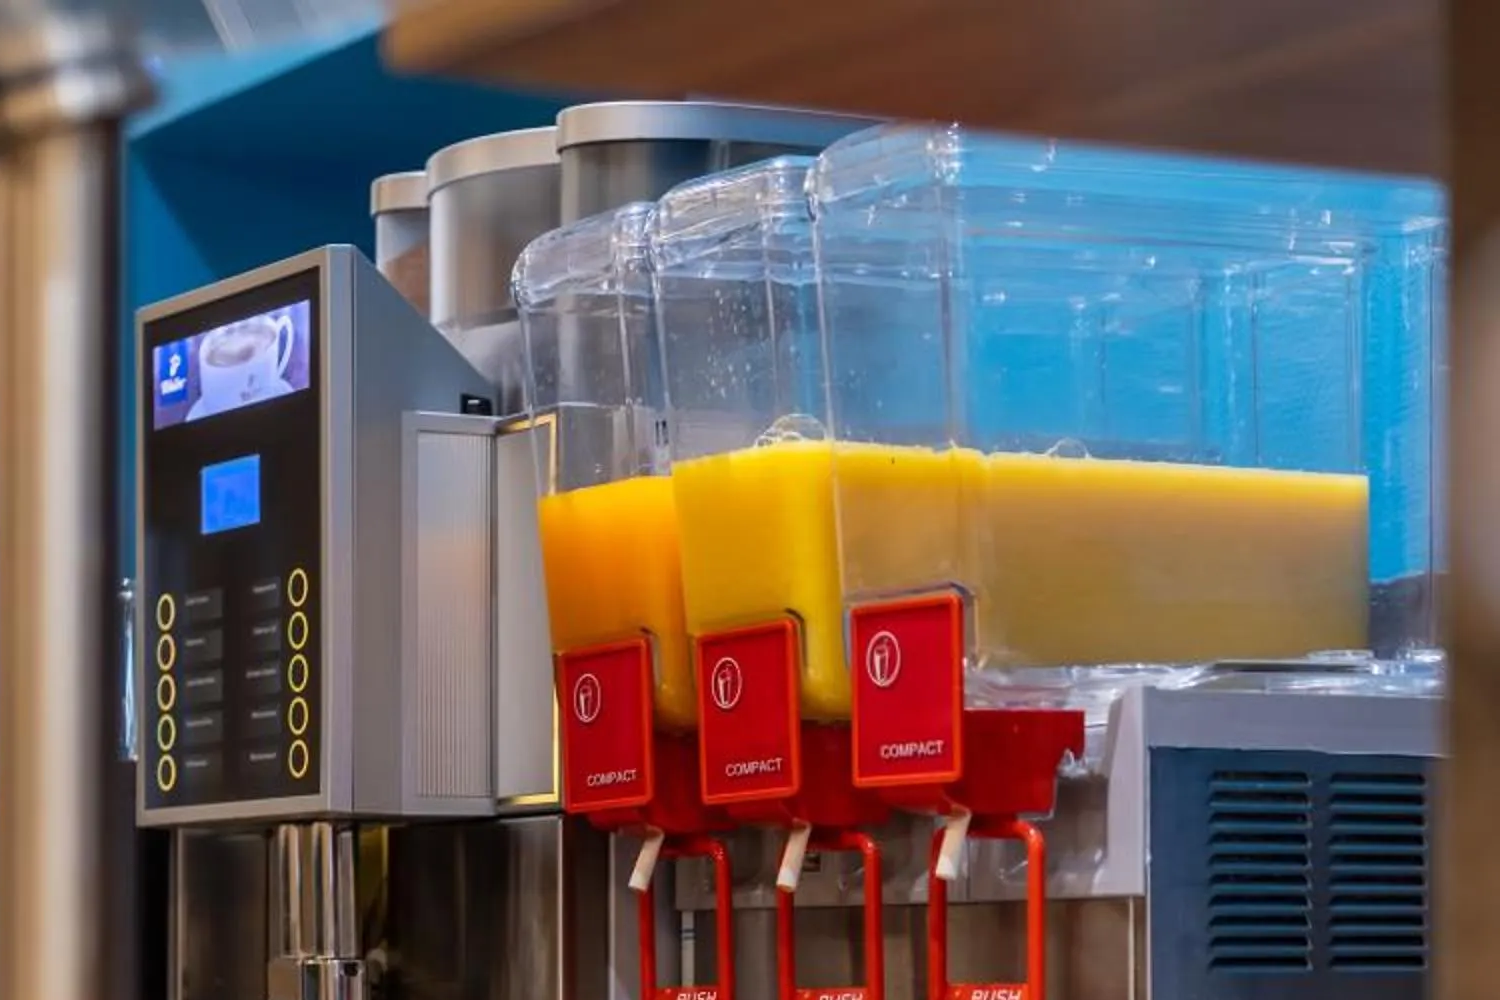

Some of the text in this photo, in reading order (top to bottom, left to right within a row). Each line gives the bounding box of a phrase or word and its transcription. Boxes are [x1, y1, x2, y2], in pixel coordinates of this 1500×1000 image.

[880, 739, 944, 759] COMPACT
[725, 757, 783, 777] COMPACT
[586, 768, 637, 787] COMPACT
